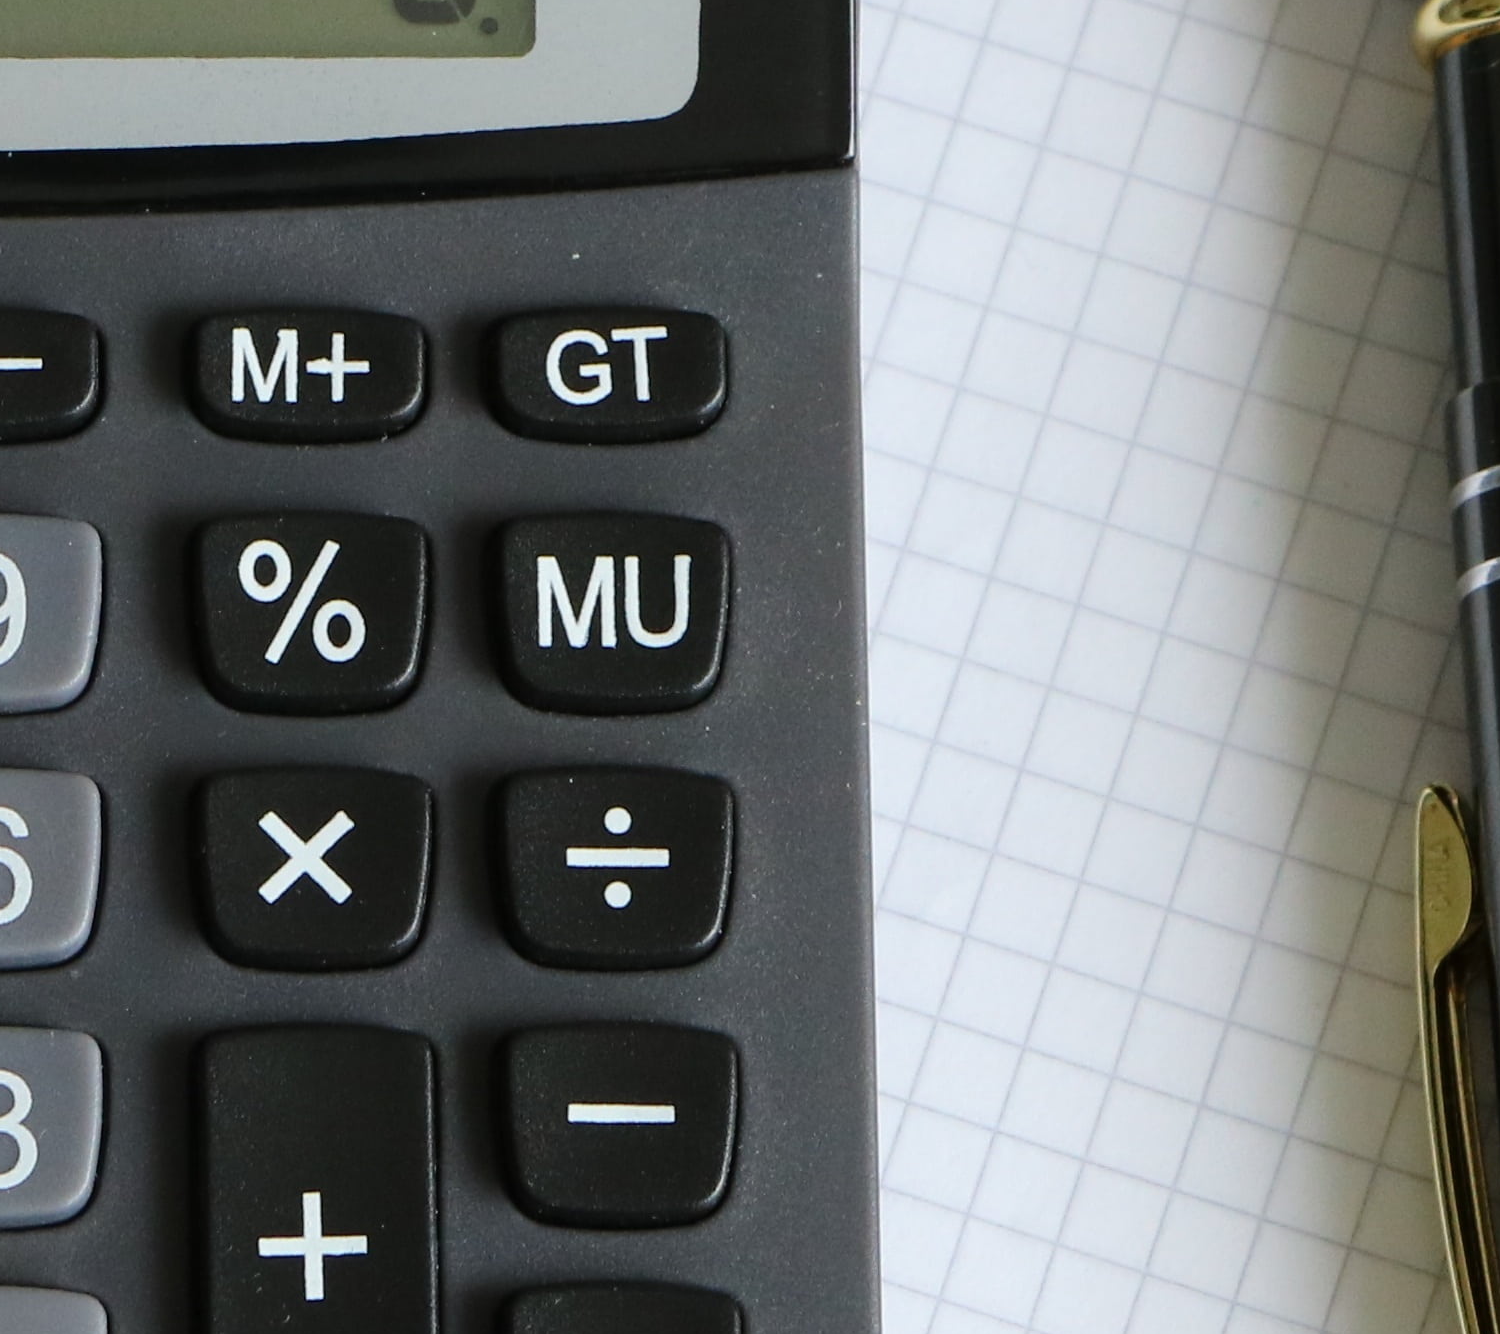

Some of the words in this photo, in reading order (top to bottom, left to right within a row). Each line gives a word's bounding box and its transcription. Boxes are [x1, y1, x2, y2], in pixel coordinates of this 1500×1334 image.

[231, 327, 370, 403] M+
[546, 326, 668, 405] GT
[238, 539, 366, 664] %
[537, 554, 691, 648] MU
